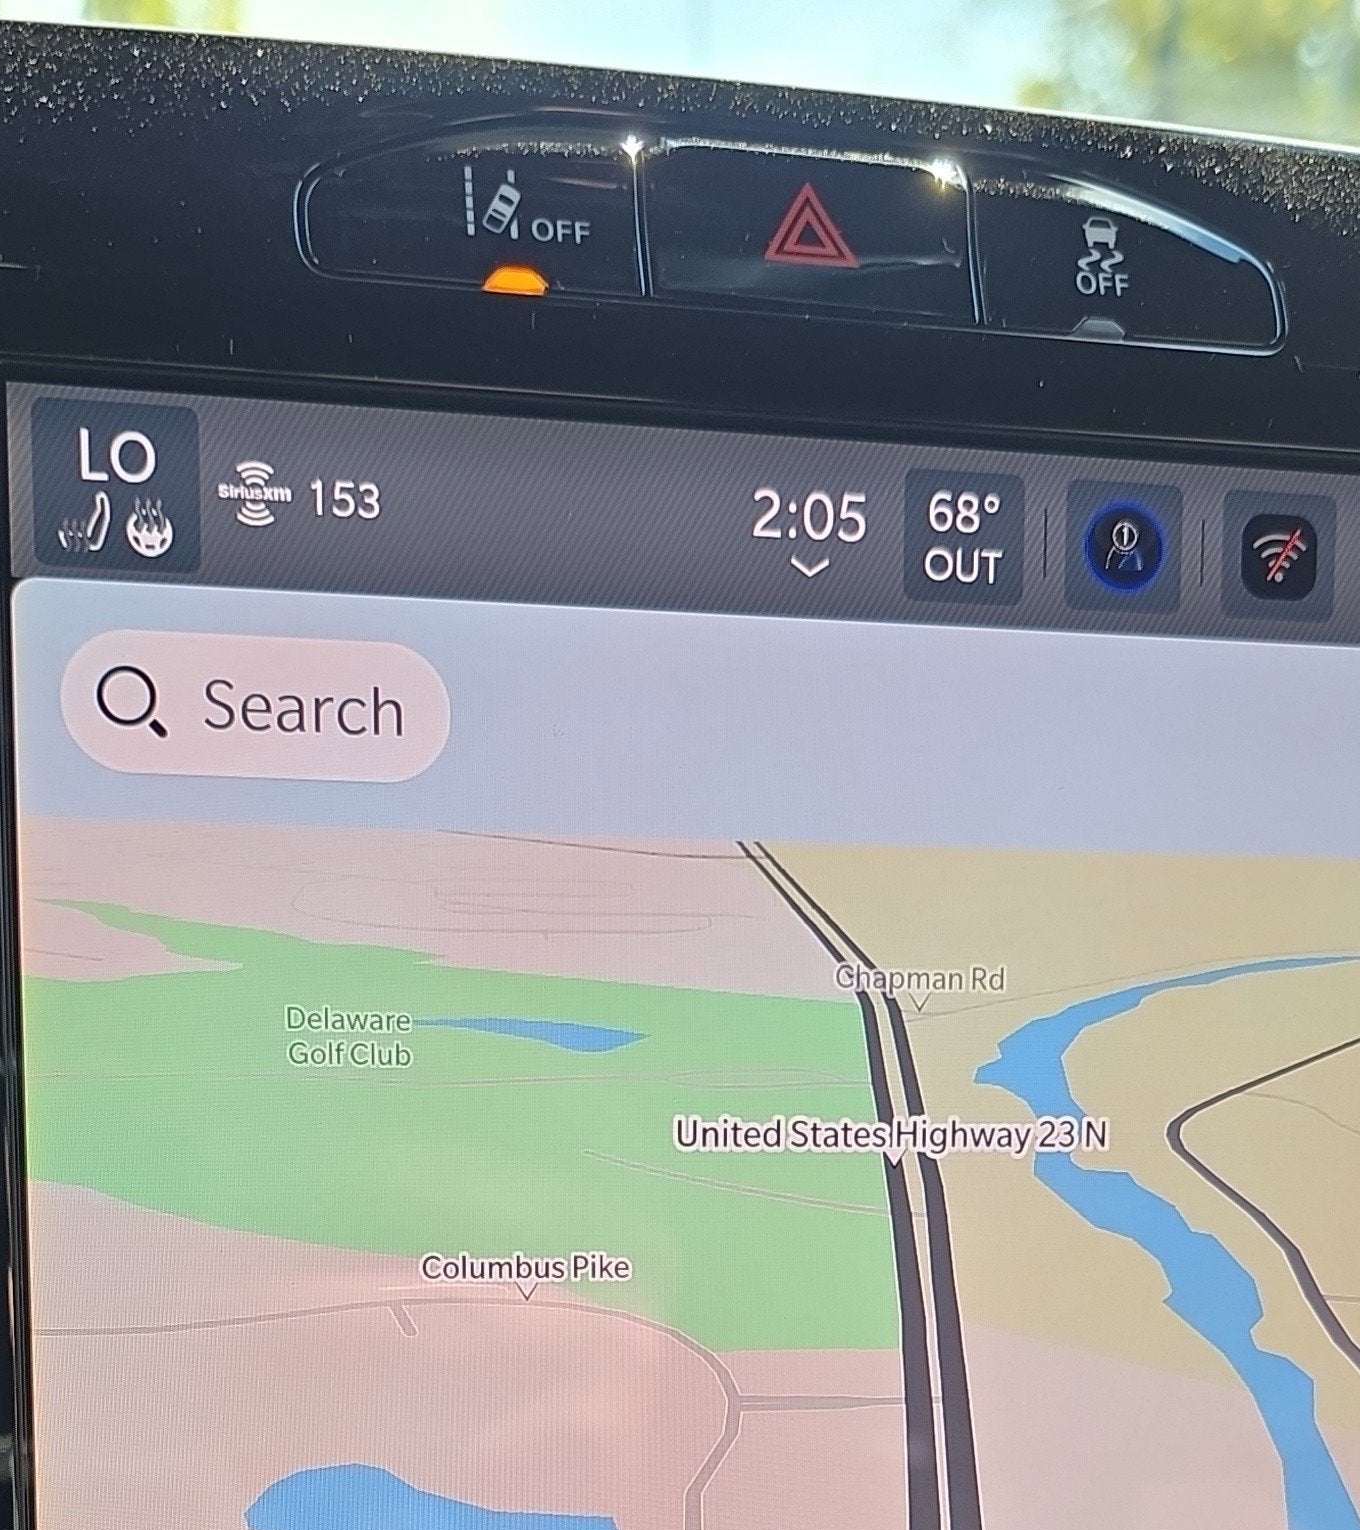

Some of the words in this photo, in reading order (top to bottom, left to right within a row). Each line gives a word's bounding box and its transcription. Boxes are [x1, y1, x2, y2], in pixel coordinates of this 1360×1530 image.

[531, 218, 591, 245] OFF
[1074, 270, 1130, 299] OFF
[78, 426, 156, 485] LO
[310, 477, 381, 519] 153
[751, 488, 867, 543] 2:05
[927, 490, 1001, 534] 68°
[923, 546, 1003, 585] OUT
[203, 678, 405, 737] Search
[835, 964, 963, 997] Chapman
[971, 966, 1005, 992] Rd
[285, 1006, 412, 1032] Delaware
[288, 1041, 343, 1066] Golf
[350, 1042, 412, 1067] Club
[676, 1119, 782, 1148] United
[790, 1120, 887, 1149] States
[896, 1121, 1032, 1154] Highway
[1038, 1122, 1075, 1148] 23
[1086, 1123, 1107, 1148] N
[421, 1255, 565, 1280] Columbus
[572, 1255, 631, 1279] Pike
